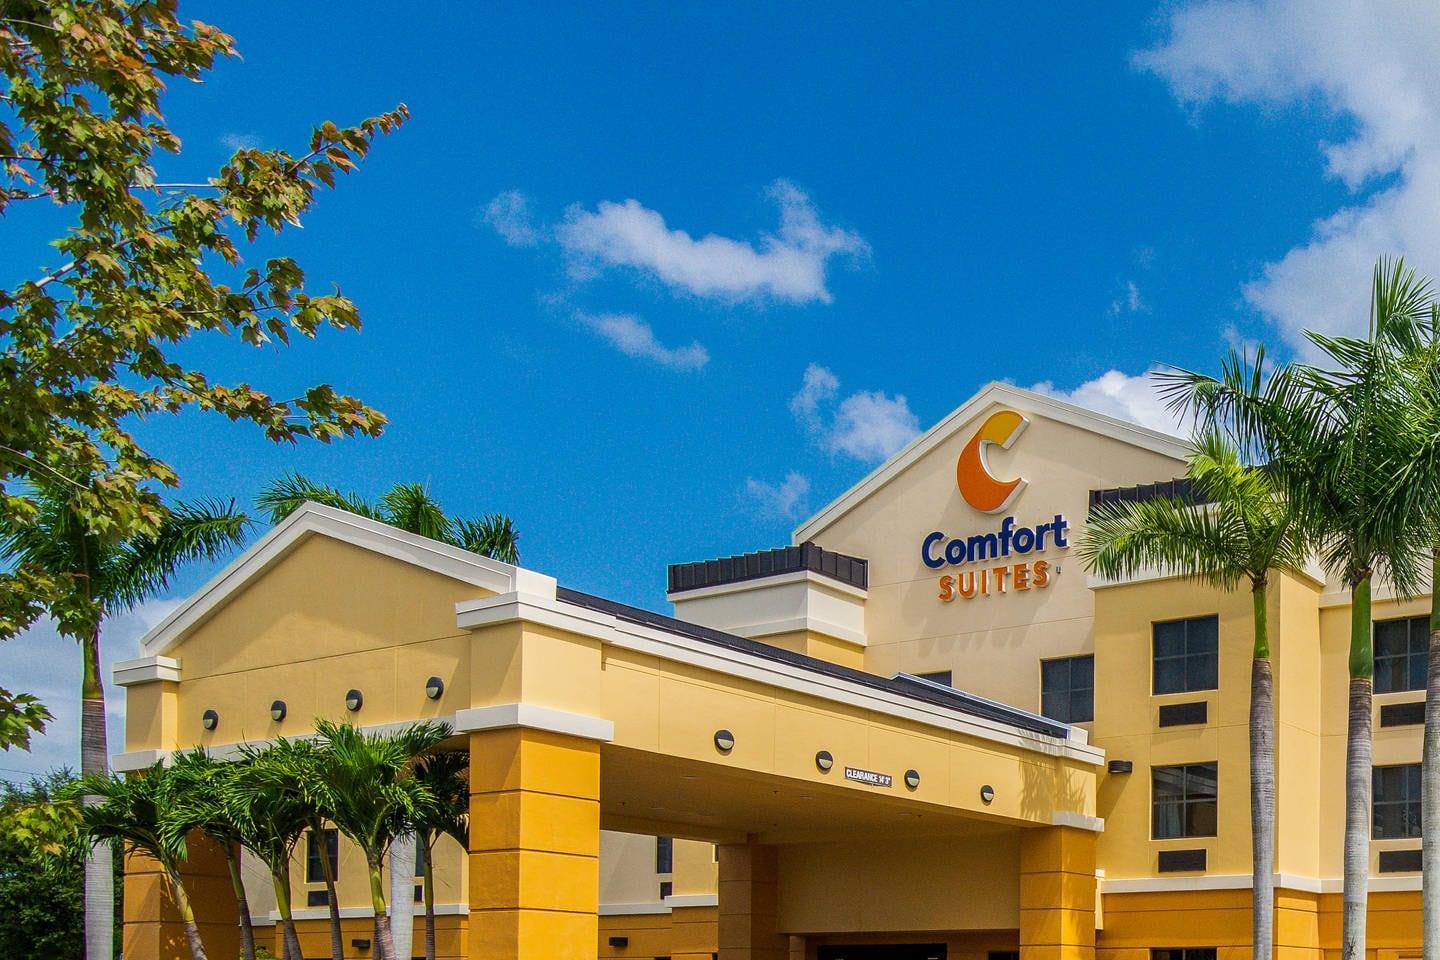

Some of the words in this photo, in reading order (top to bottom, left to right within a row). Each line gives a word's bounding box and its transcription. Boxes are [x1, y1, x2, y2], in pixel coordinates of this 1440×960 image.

[922, 515, 1069, 570] Comfort
[939, 560, 1049, 602] SUITES
[846, 768, 878, 783] CLEARANCE
